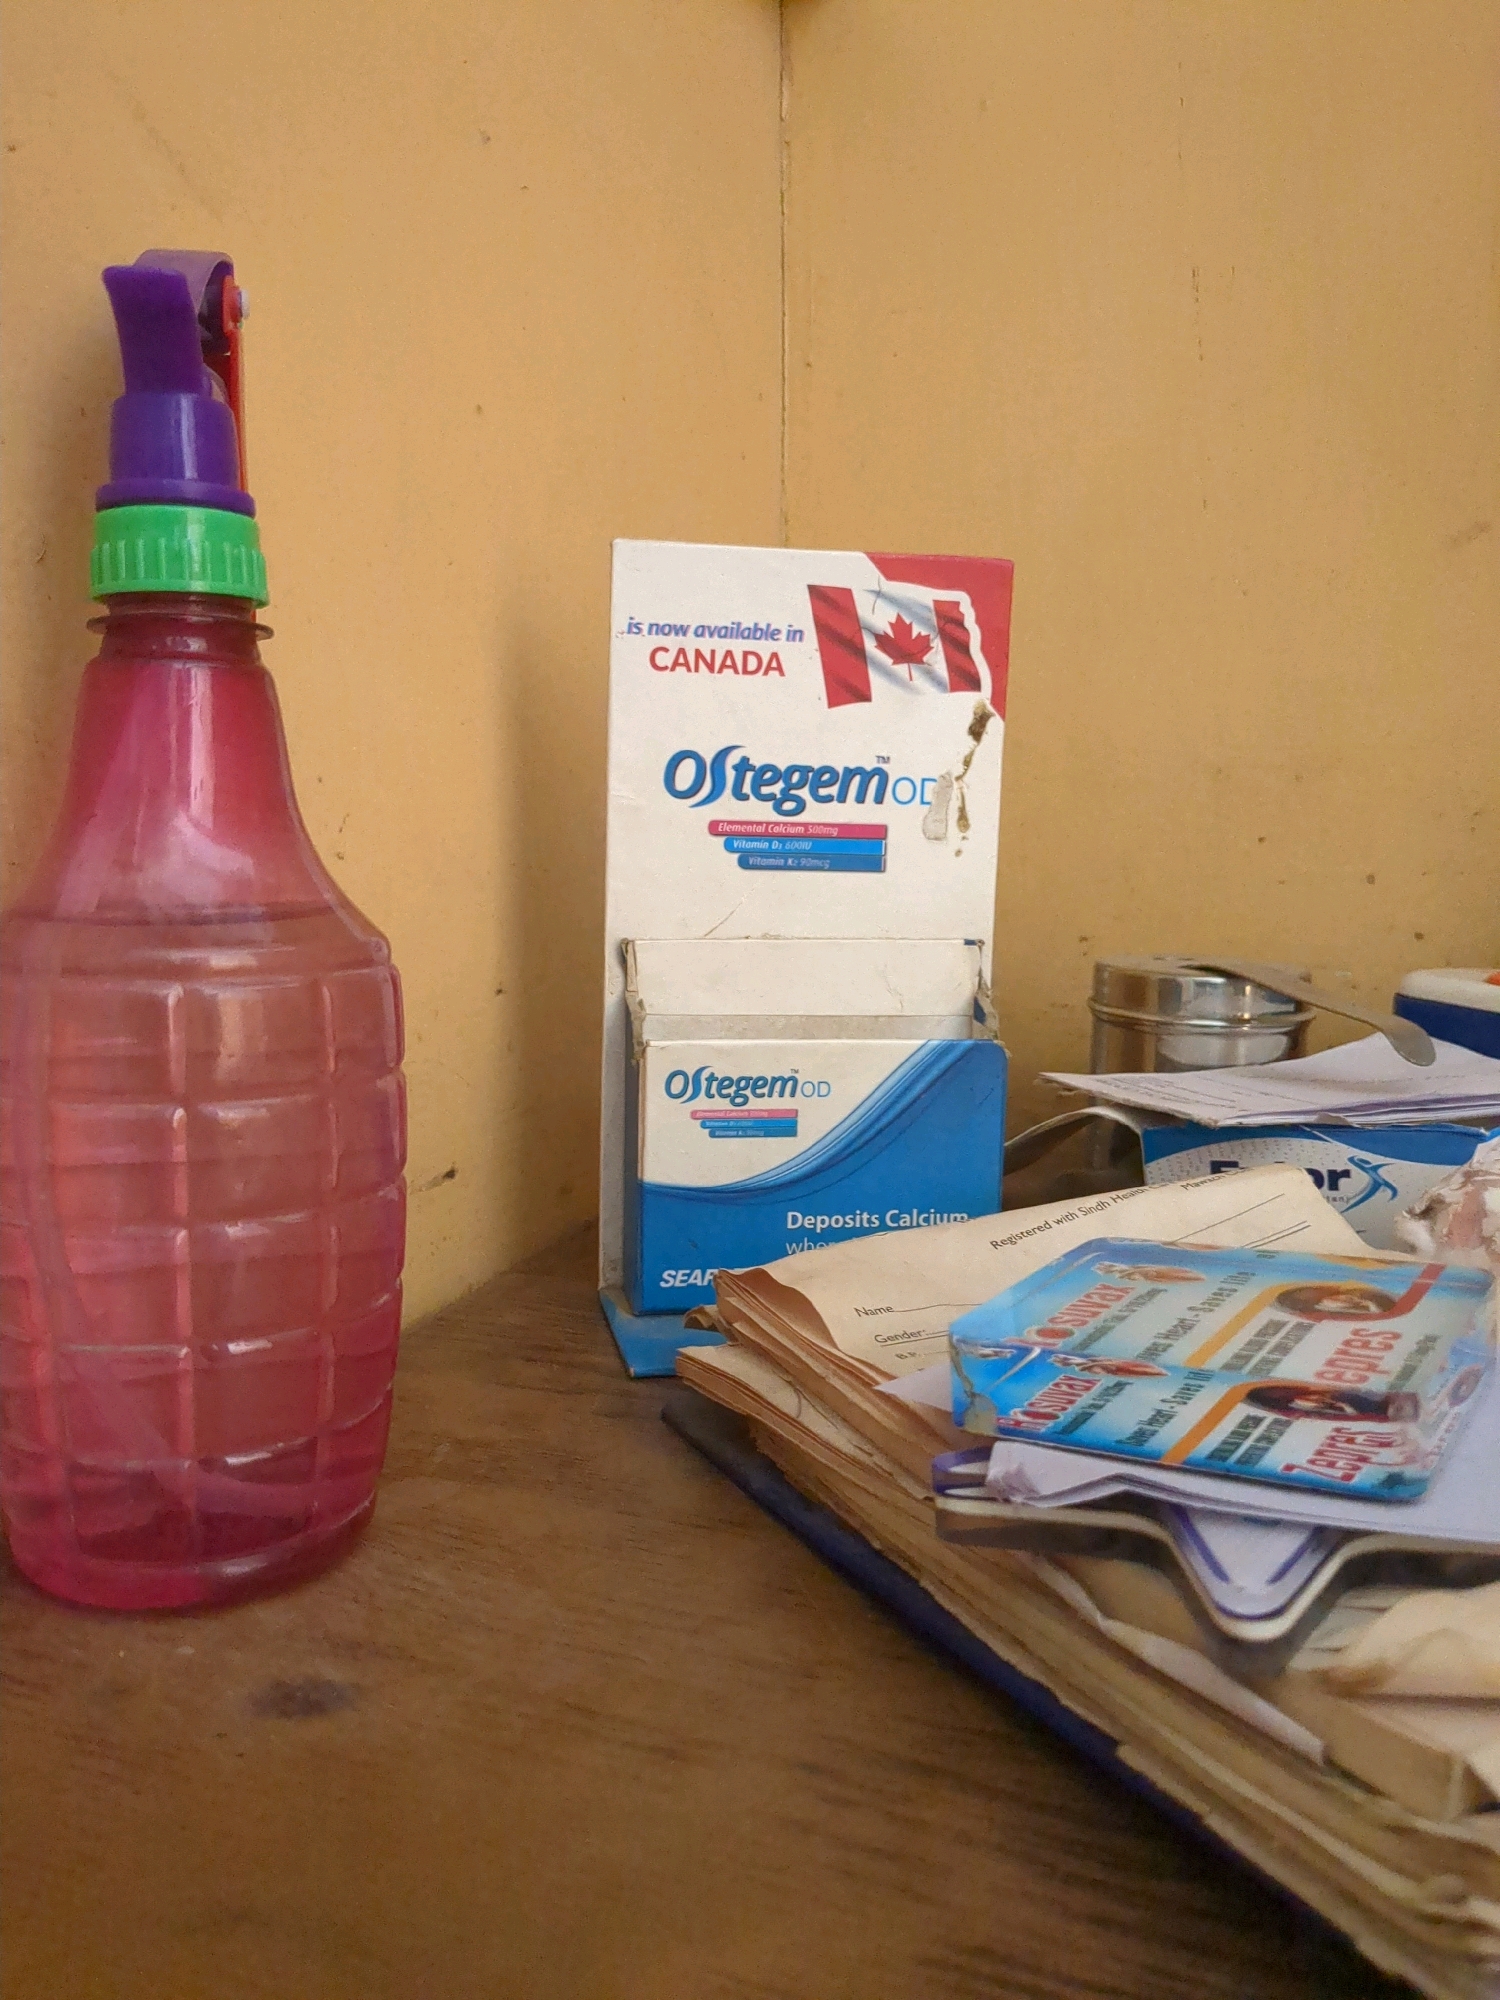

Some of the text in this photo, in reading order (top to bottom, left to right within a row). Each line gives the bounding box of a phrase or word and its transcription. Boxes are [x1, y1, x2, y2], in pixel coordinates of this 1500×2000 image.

[626, 616, 805, 643] is now available in
[649, 646, 786, 677] CANADA
[718, 822, 839, 837] Elemental Calcium 500mg
[733, 839, 769, 850] Vitamin
[748, 856, 784, 867] Vitamin
[800, 1080, 832, 1098] OD
[786, 1208, 968, 1234] Deposits Calcium
[989, 1219, 1053, 1250] Registered
[1052, 1210, 1080, 1226] with
[1077, 1200, 1111, 1217] Sindh
[853, 1304, 895, 1318] Name
[1312, 1326, 1402, 1385] epres
